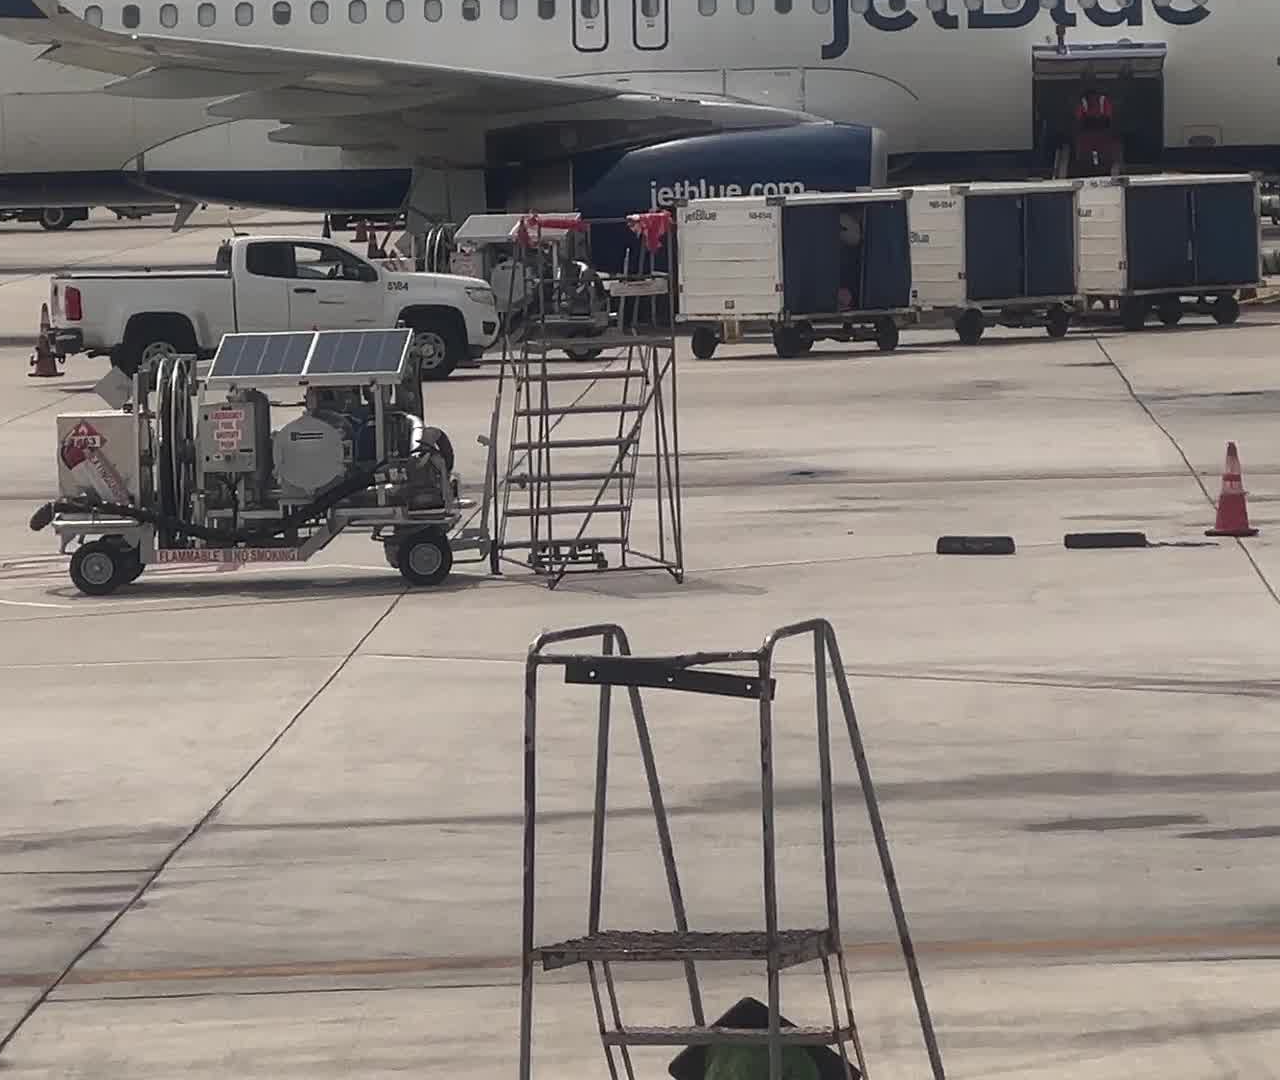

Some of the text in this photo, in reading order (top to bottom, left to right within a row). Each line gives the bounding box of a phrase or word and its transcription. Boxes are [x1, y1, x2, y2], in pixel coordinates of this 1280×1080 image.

[650, 178, 805, 209] jetbluecom
[685, 209, 717, 223] jetBlue
[159, 549, 219, 562] FLAMMABLE
[234, 549, 298, 562] NO SMOKING
